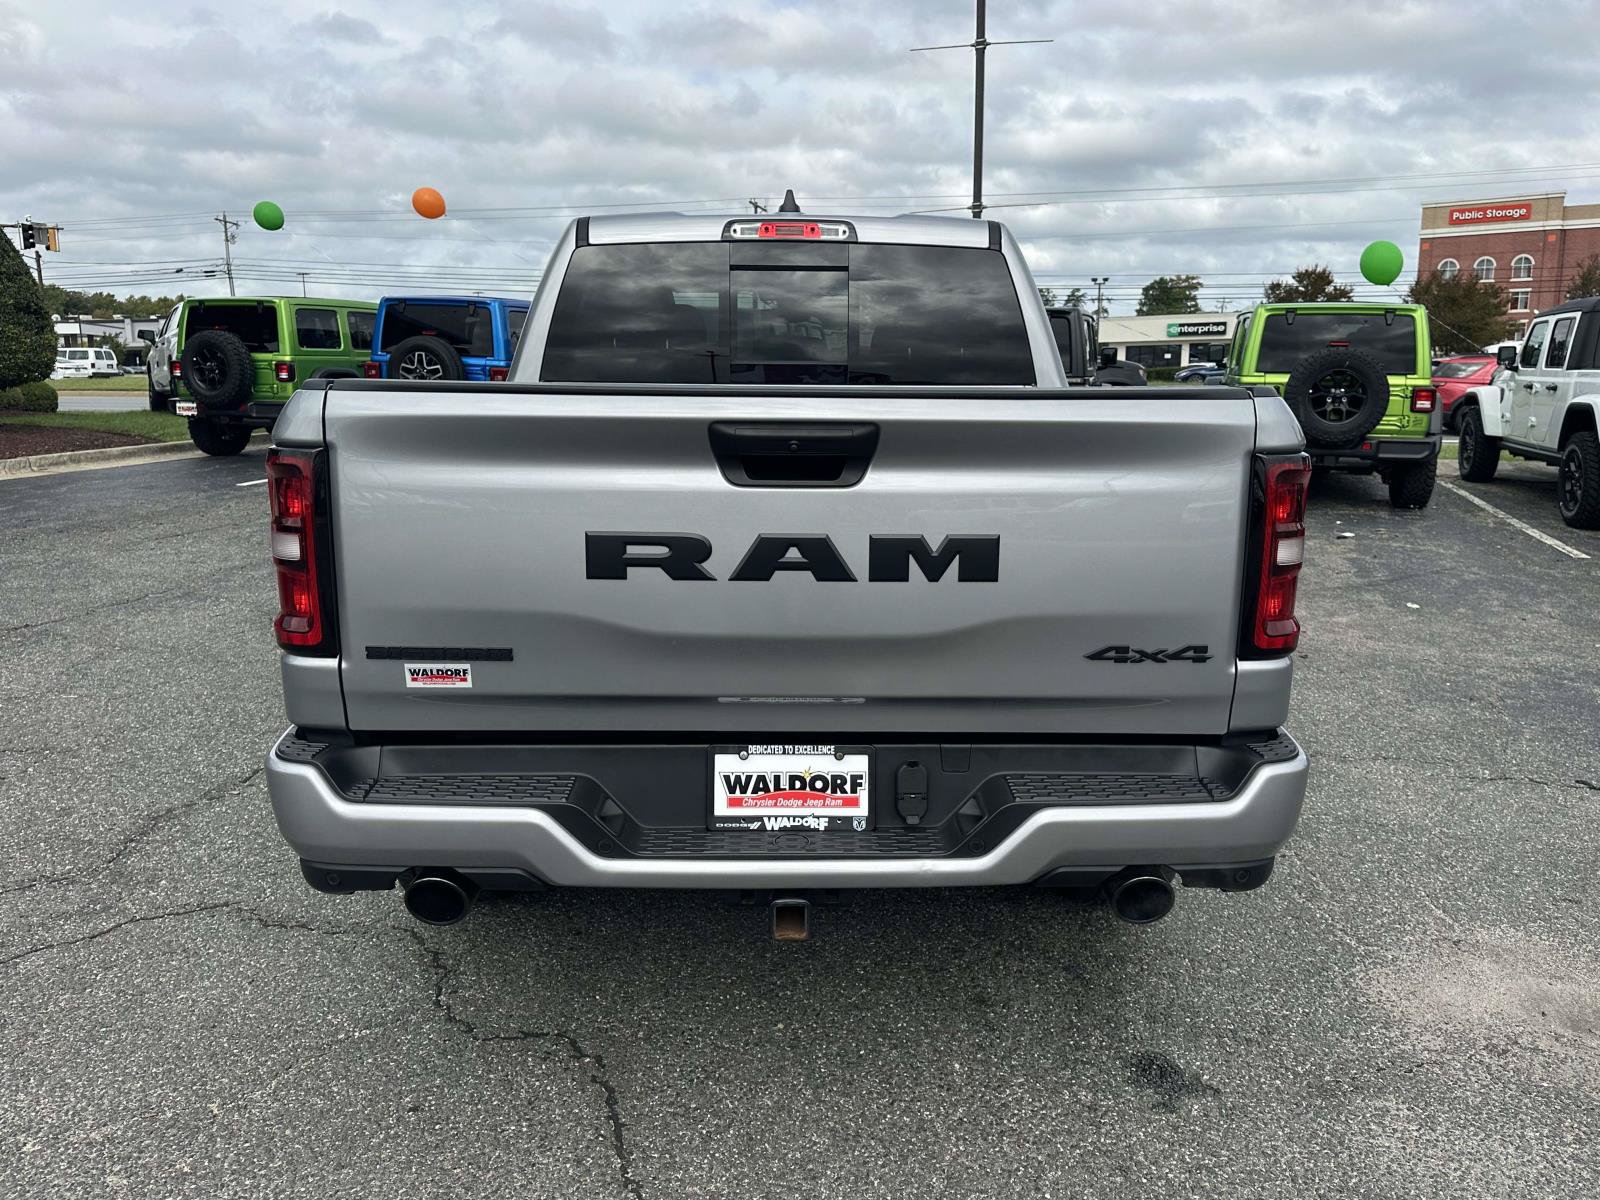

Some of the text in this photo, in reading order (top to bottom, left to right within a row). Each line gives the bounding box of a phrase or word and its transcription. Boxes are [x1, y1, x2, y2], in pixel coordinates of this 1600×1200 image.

[1452, 207, 1527, 220] Public Storage
[1168, 323, 1225, 334] enterprise
[585, 531, 1000, 583] RAM
[1083, 645, 1214, 664] 4x4
[408, 668, 469, 677] WALDORF
[748, 745, 835, 754] DEDICATED TO EXCELLENCE
[721, 773, 865, 795] WALDORF
[742, 798, 843, 807] Chrysler Dodge Jeep Ram
[763, 816, 829, 831] WALDORF
